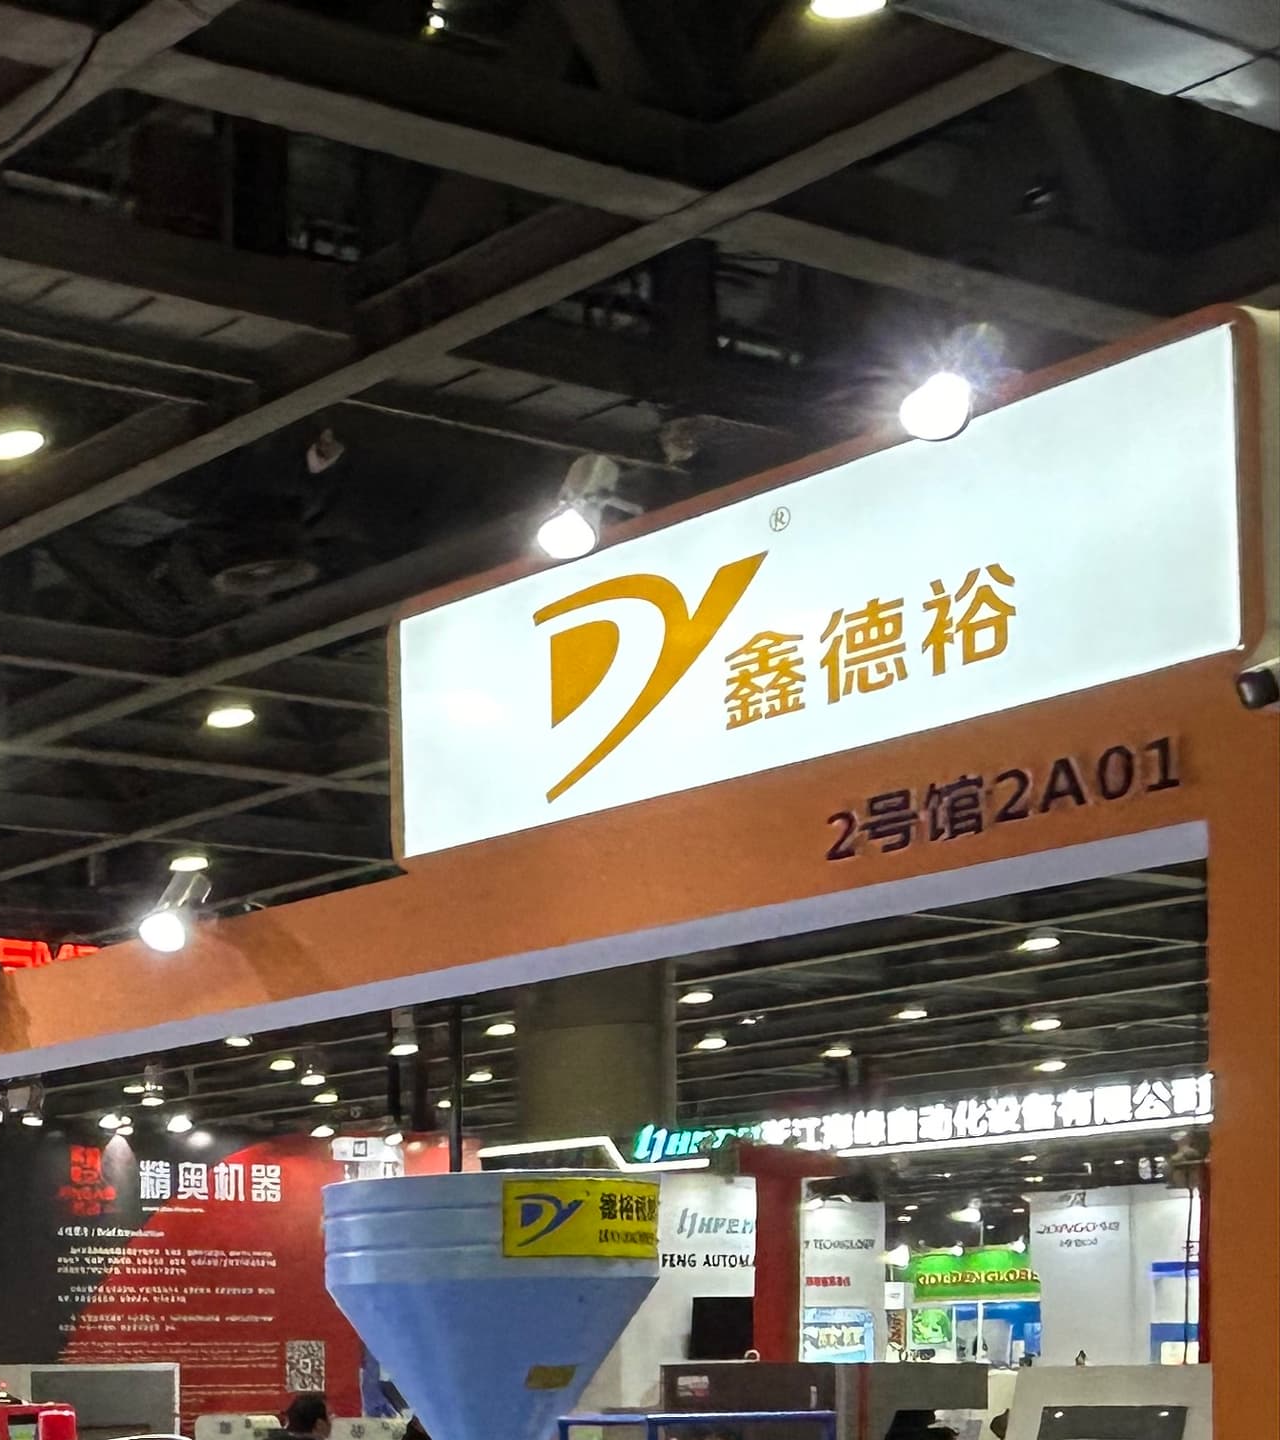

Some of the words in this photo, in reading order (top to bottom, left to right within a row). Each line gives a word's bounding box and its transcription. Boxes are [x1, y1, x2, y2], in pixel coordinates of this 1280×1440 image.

[725, 562, 1017, 731] 鑫德裕
[827, 736, 1181, 861] 2号馆2A01
[139, 1160, 282, 1203] 精奥机器
